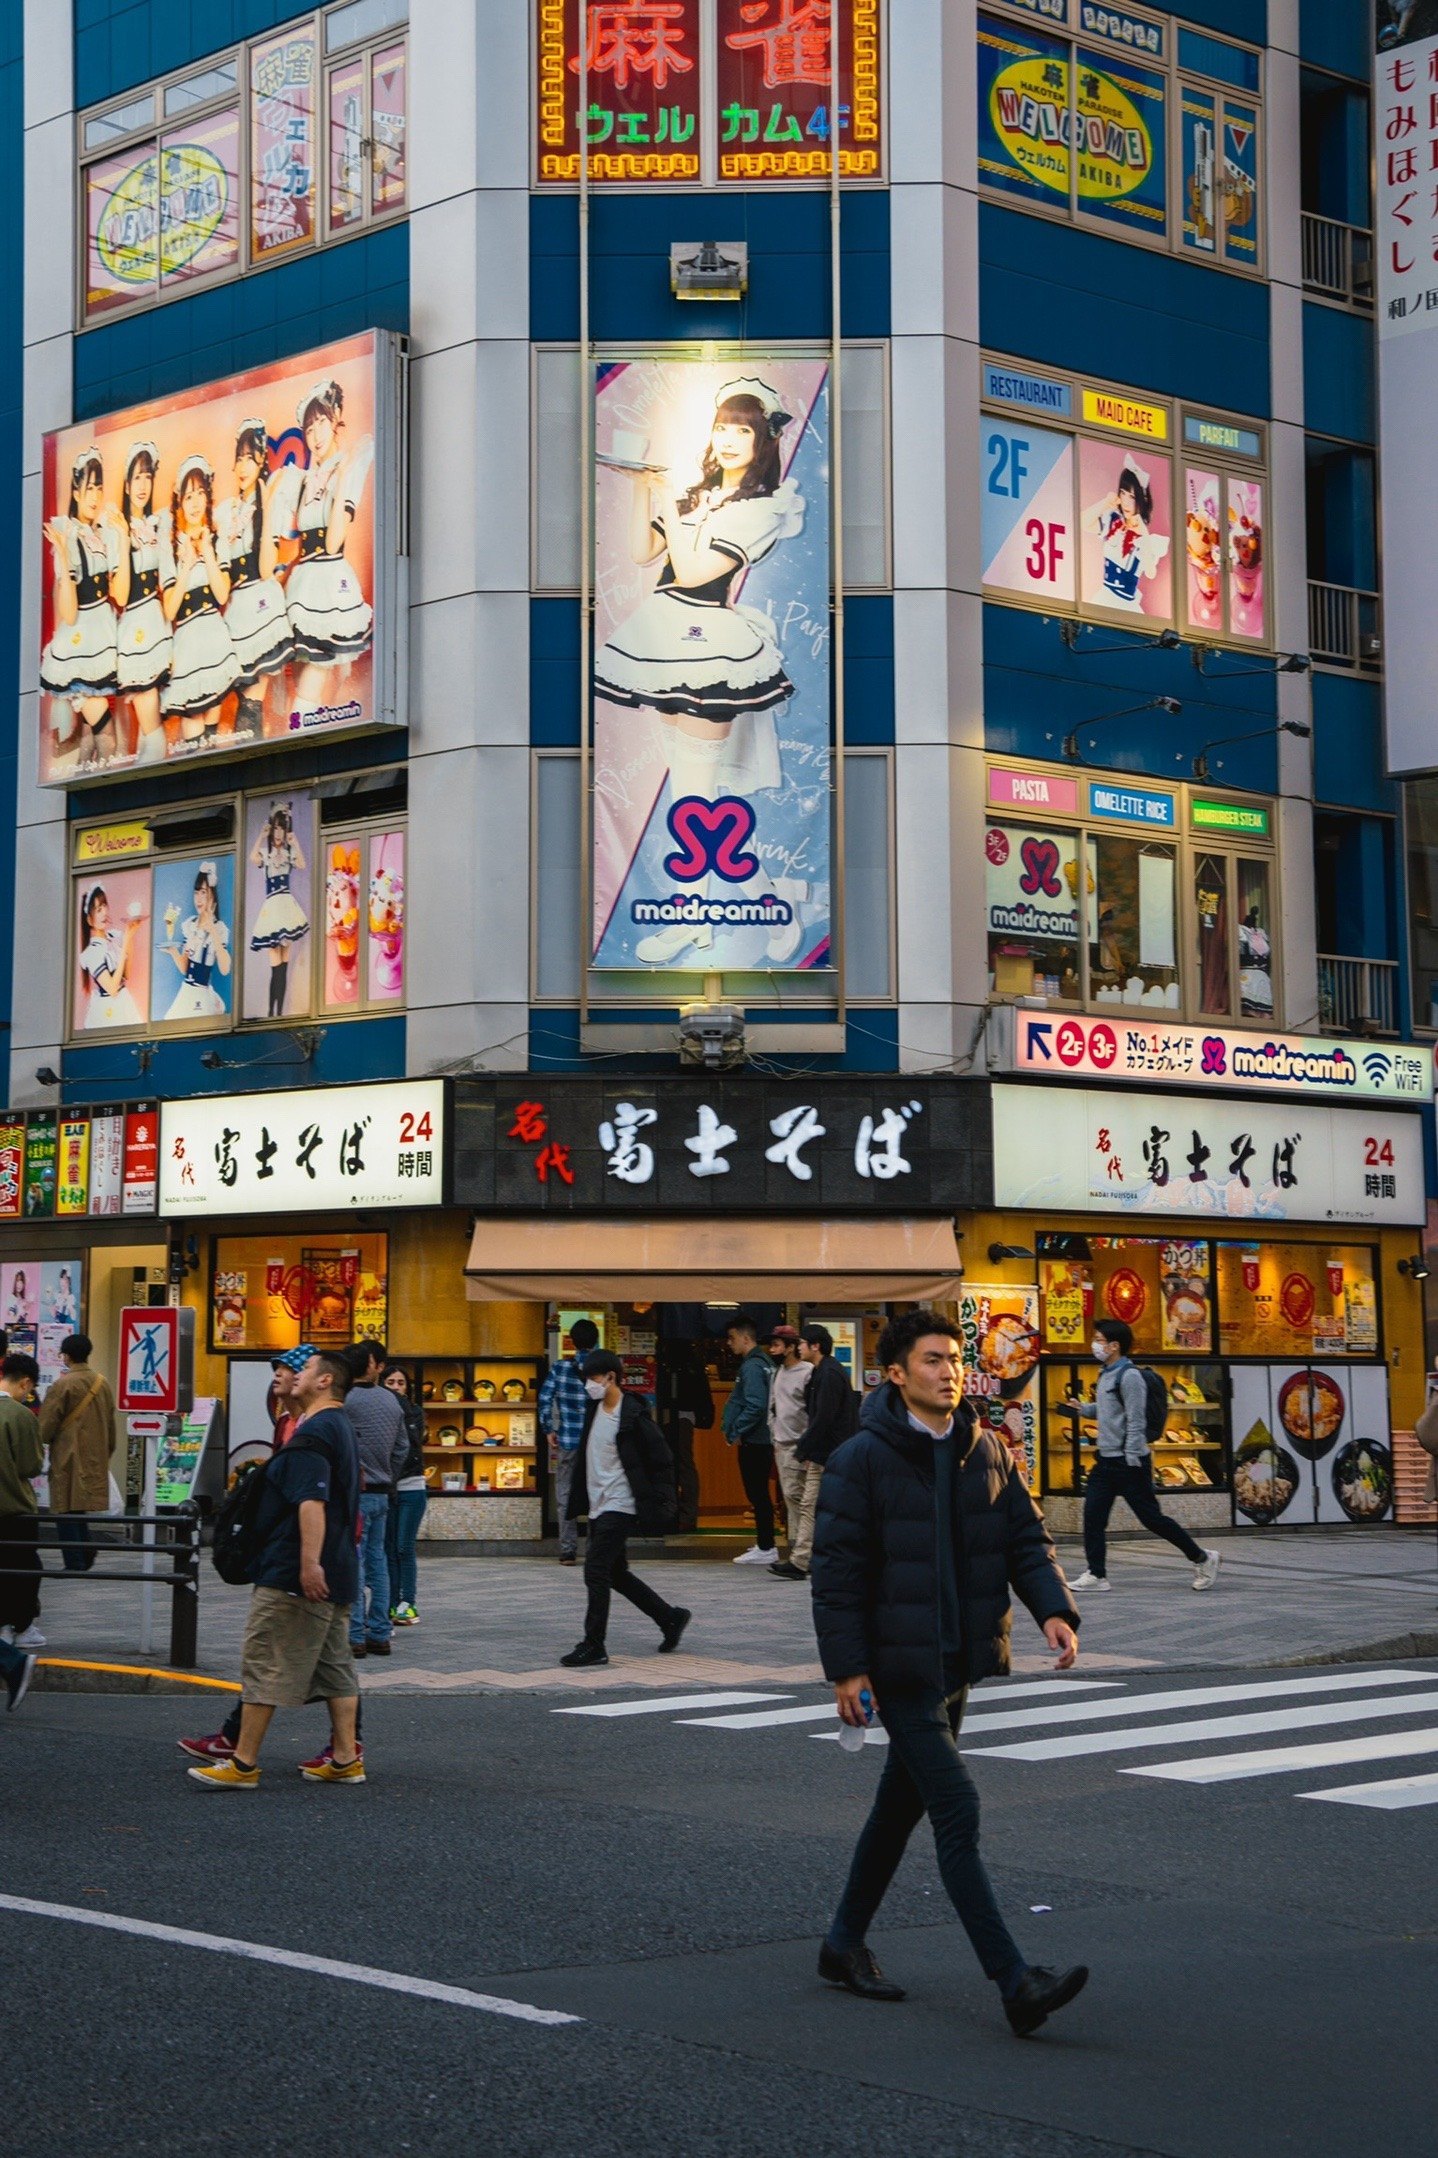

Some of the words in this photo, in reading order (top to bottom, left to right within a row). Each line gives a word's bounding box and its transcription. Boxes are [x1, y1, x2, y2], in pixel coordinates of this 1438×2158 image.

[568, 0, 832, 89] 麻雀
[1020, 80, 1066, 103] HAKOTEN
[1041, 62, 1100, 101] 麻雀
[575, 102, 803, 143] ウェルカム
[1077, 97, 1124, 119] PARADISE
[997, 87, 1147, 169] WELCOME
[1016, 146, 1067, 175] ウェルカム
[1386, 58, 1418, 275] もみほぐし
[1079, 164, 1123, 190] AKIBA
[263, 223, 305, 250] AKIBA
[989, 374, 1063, 408] RESTAURANT
[1096, 397, 1123, 424] MAID
[1126, 406, 1153, 432] CAFE
[1199, 423, 1240, 449] PARFAIT
[988, 433, 1030, 499] 2F
[1025, 517, 1066, 582] 3F
[303, 701, 361, 728] maidreamin
[1011, 778, 1050, 803] PASTA
[1094, 790, 1144, 817] OMELETTE
[1145, 803, 1168, 821] RICE
[987, 833, 1000, 846] 3F
[632, 894, 793, 926] maidreamin
[991, 903, 1091, 938] maidreami
[1061, 1031, 1084, 1057] 2F
[1092, 1033, 1116, 1060] 3F
[1126, 1031, 1194, 1056] No.1メイド
[1126, 1055, 1194, 1073] カフェグループ
[1233, 1042, 1357, 1085] maidreamin
[1394, 1054, 1423, 1074] Free
[1394, 1073, 1424, 1092] WiFi
[399, 1111, 433, 1144] 24
[171, 1136, 196, 1186] 名代
[214, 1114, 372, 1188] 富士そば
[507, 1100, 574, 1186] 名代
[599, 1100, 923, 1185] 富士そば
[1095, 1127, 1124, 1182] 名代
[1142, 1125, 1303, 1189] 富士そば
[1364, 1137, 1395, 1167] 24
[397, 1151, 433, 1179] 時間
[1364, 1173, 1396, 1199] 時間
[1163, 1243, 1208, 1270] かつ丼
